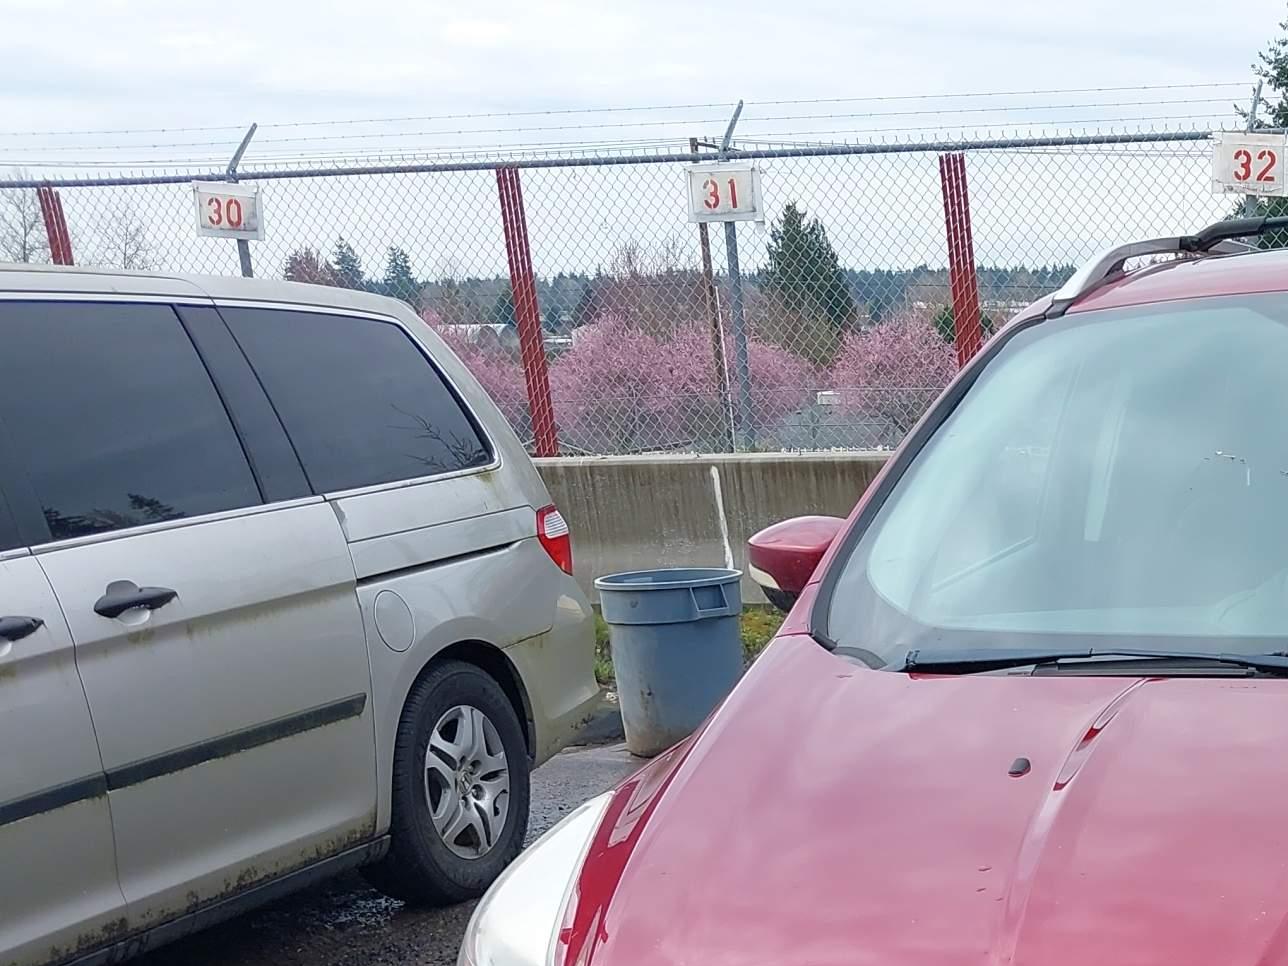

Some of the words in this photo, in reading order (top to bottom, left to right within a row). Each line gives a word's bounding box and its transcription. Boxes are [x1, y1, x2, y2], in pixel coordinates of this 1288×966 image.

[1233, 149, 1277, 183] 32
[703, 178, 738, 210] 31
[207, 197, 243, 227] 30
